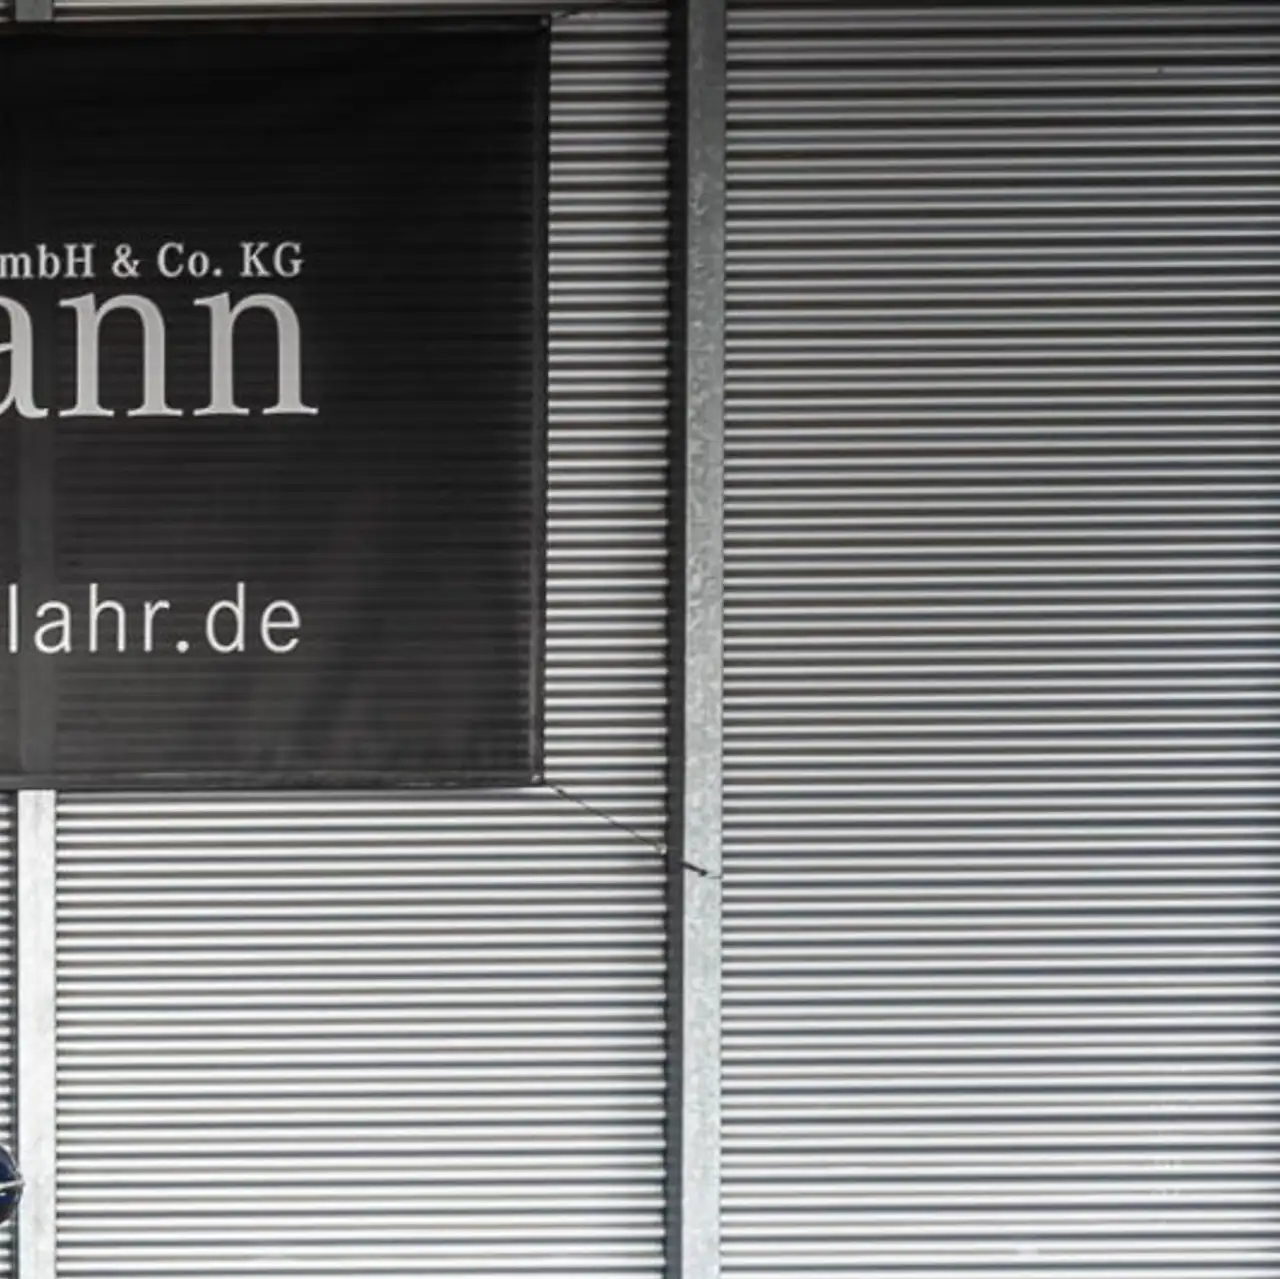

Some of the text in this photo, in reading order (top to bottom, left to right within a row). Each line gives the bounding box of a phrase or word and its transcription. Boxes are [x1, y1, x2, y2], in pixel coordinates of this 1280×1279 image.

[111, 243, 140, 279] &
[157, 243, 223, 278] Co.
[241, 242, 304, 278] KG
